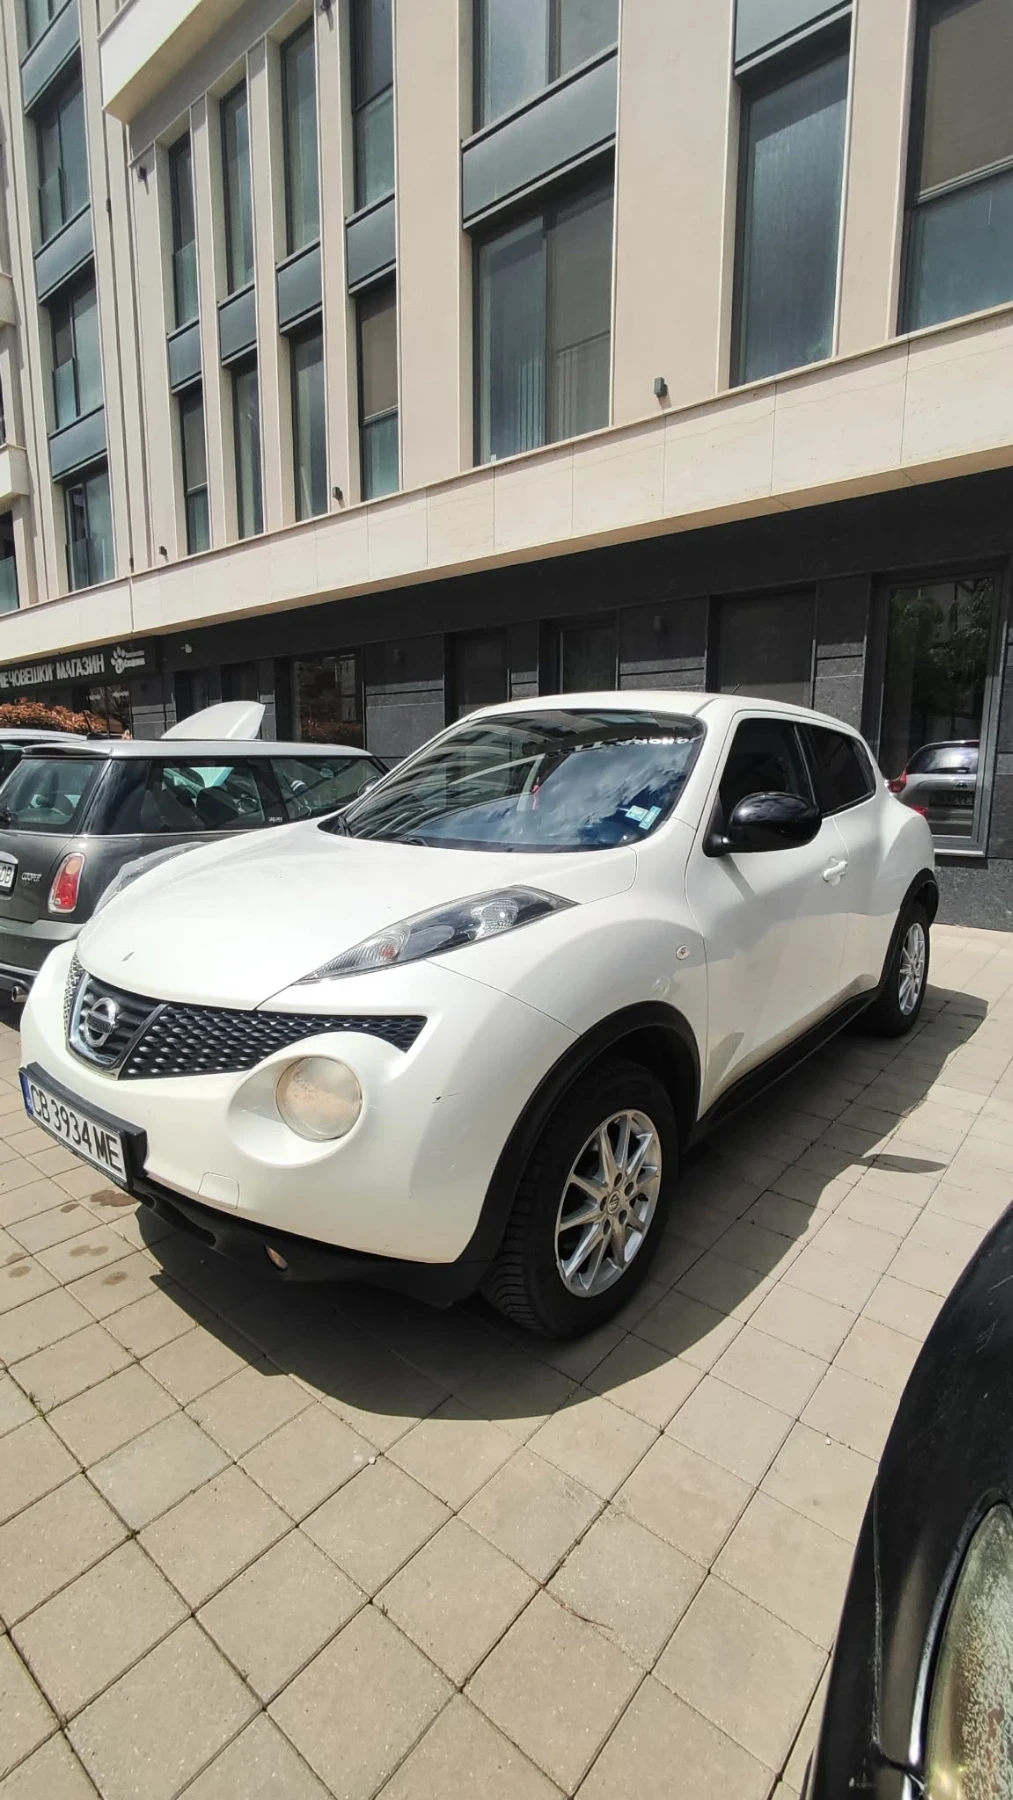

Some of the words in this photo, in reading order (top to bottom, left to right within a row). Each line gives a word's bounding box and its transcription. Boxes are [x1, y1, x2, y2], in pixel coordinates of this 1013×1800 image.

[0, 663, 54, 689] ЕЧОВЕШКИ
[56, 654, 105, 680] МАГАЗИН
[51, 1098, 92, 1154] 3934
[93, 1125, 122, 1173] ME
